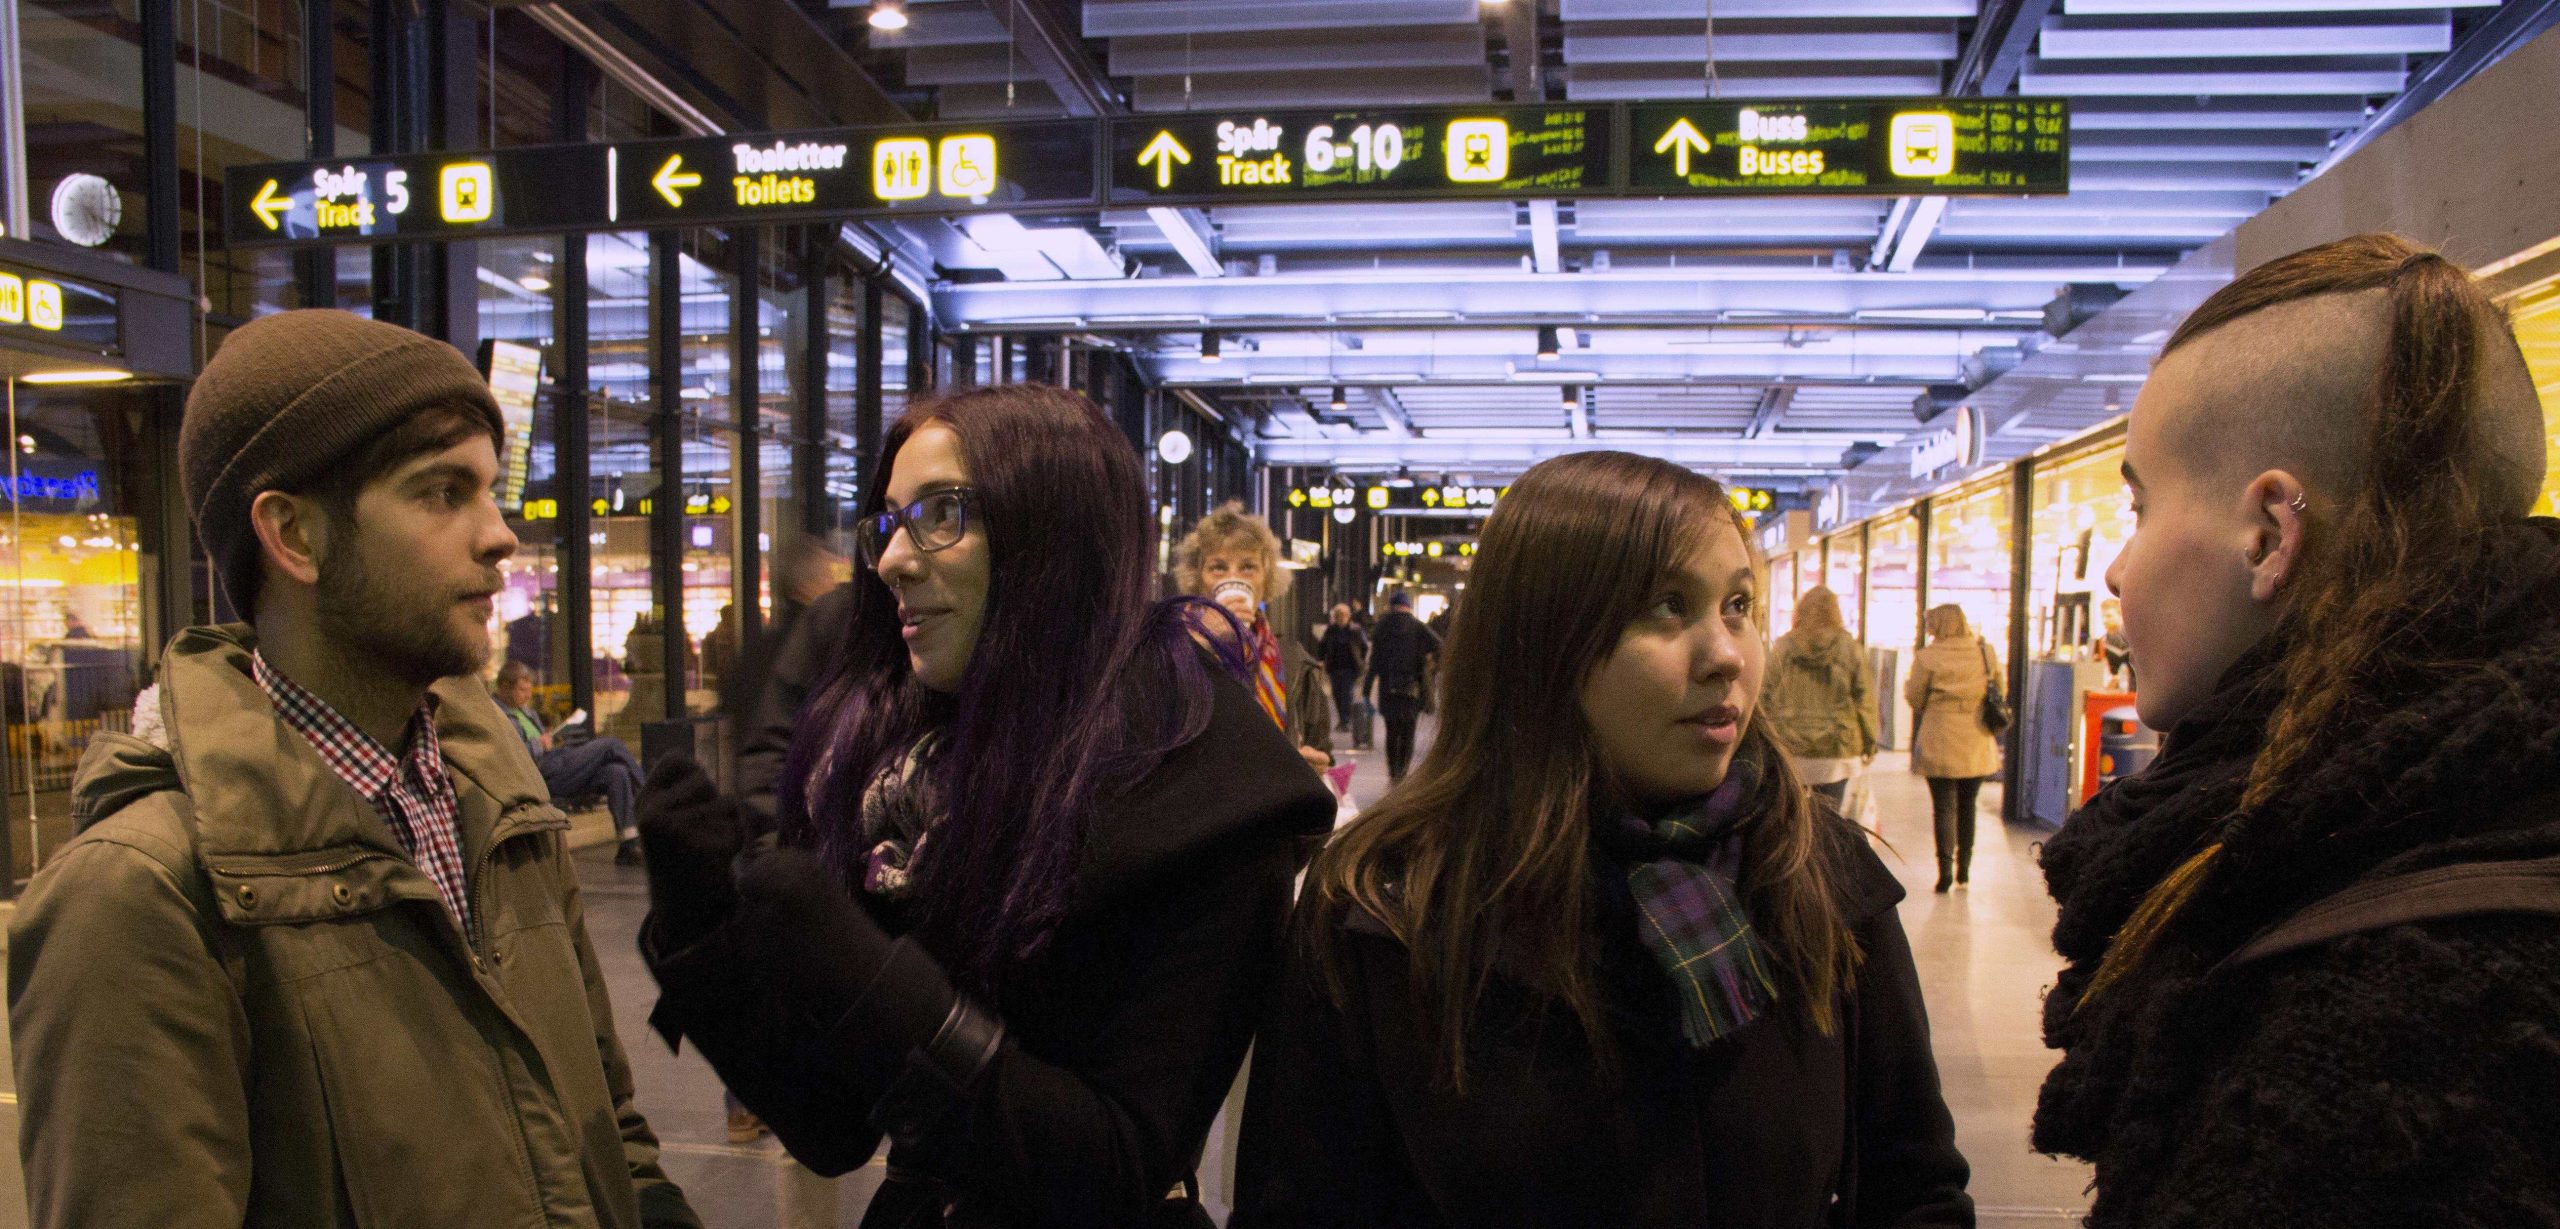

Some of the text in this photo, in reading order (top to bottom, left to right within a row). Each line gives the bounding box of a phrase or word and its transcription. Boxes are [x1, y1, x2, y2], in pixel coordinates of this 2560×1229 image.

[1217, 118, 1283, 157] Spår
[1739, 109, 1807, 142] Buss
[733, 141, 847, 173] Toaletter
[1305, 123, 1403, 172] 6-10
[1739, 146, 1824, 176] Buses
[313, 165, 367, 202] Spår
[1217, 154, 1292, 185] Track
[385, 171, 409, 214] 5
[734, 174, 815, 205] Toilets
[316, 199, 375, 228] Track
